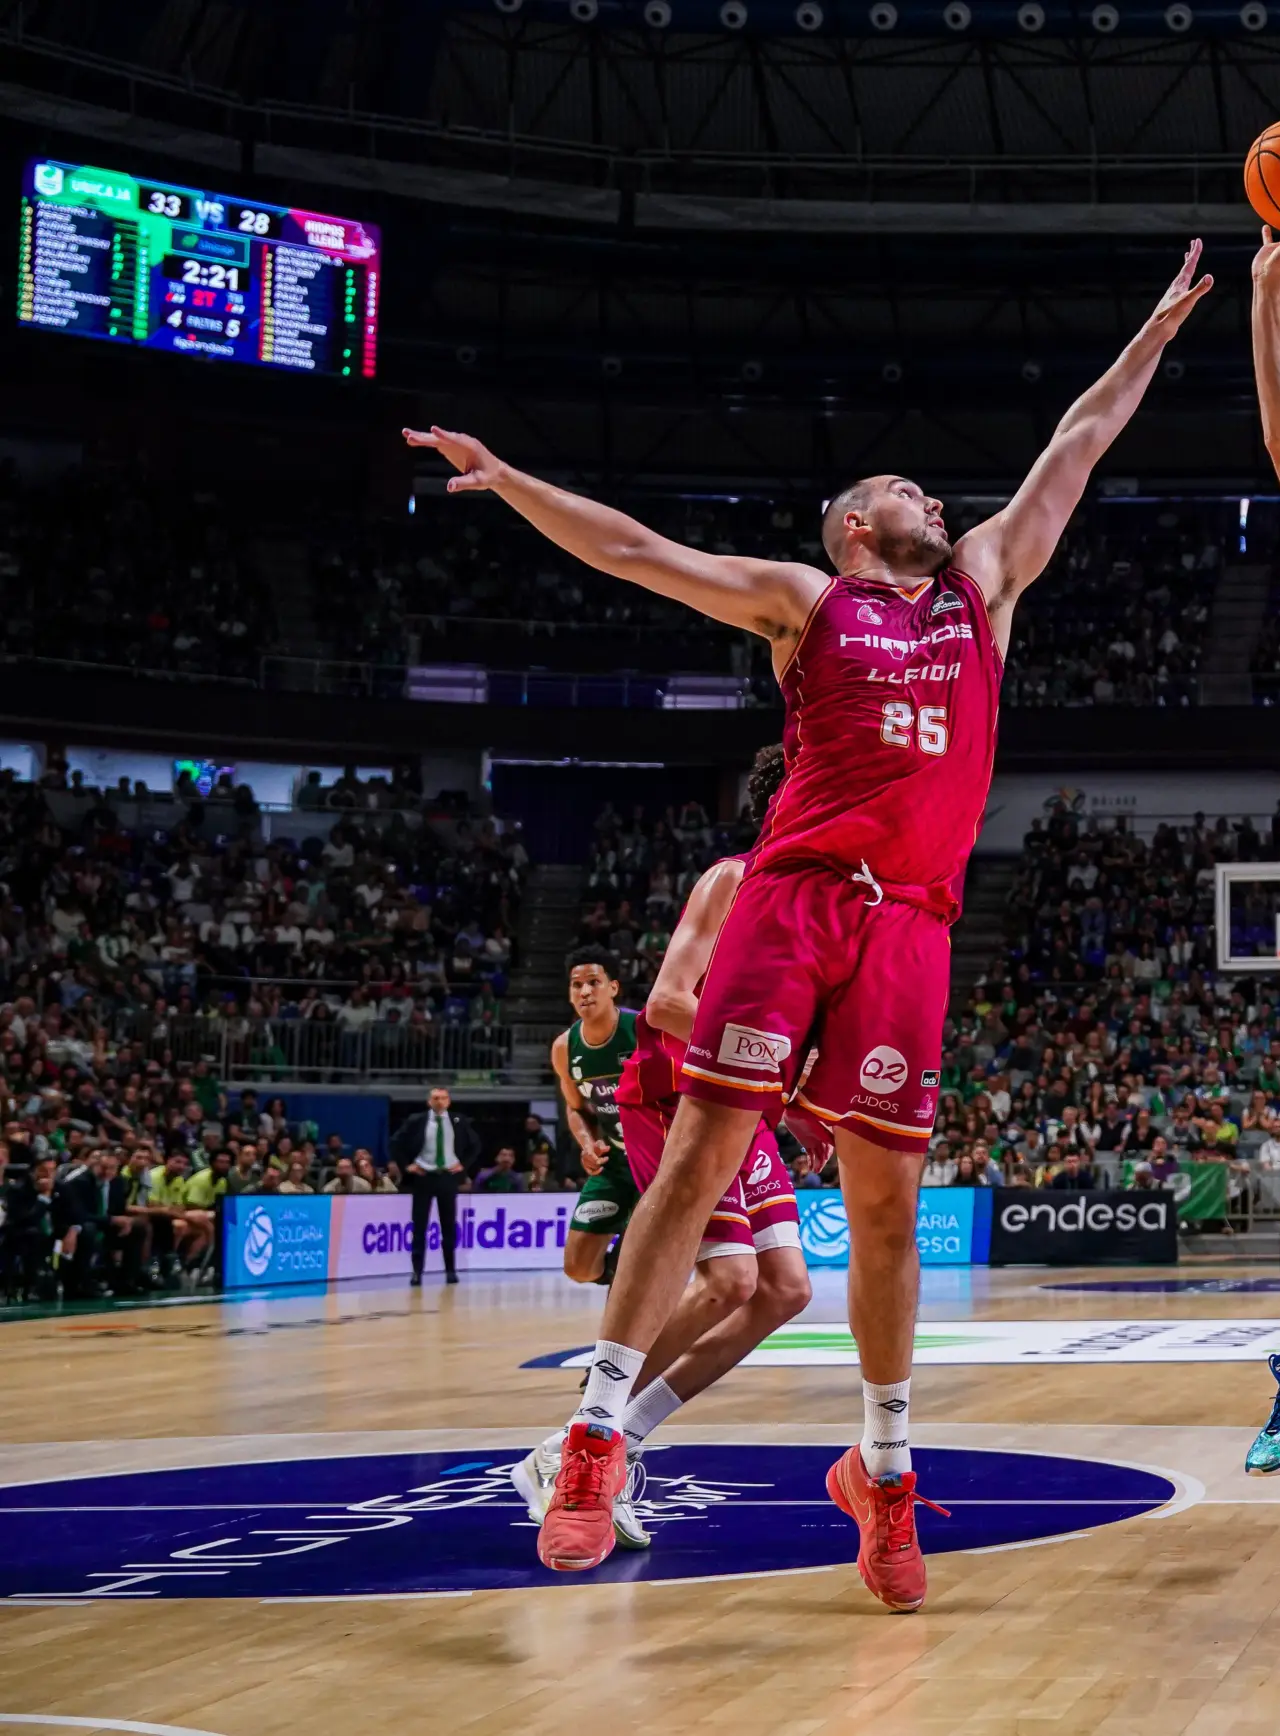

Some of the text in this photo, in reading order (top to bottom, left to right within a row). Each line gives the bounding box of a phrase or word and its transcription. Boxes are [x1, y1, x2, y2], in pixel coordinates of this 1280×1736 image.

[148, 192, 270, 235] 33 VS 28
[182, 260, 238, 291] 2:21
[166, 309, 183, 328] 4
[225, 319, 241, 338] 5
[867, 662, 961, 684] LLEIDA
[880, 700, 948, 756] 25
[863, 1058, 905, 1083] Q2
[923, 1077, 936, 1085] acb
[1000, 1195, 1166, 1232] endesa
[918, 1236, 960, 1253] esa
